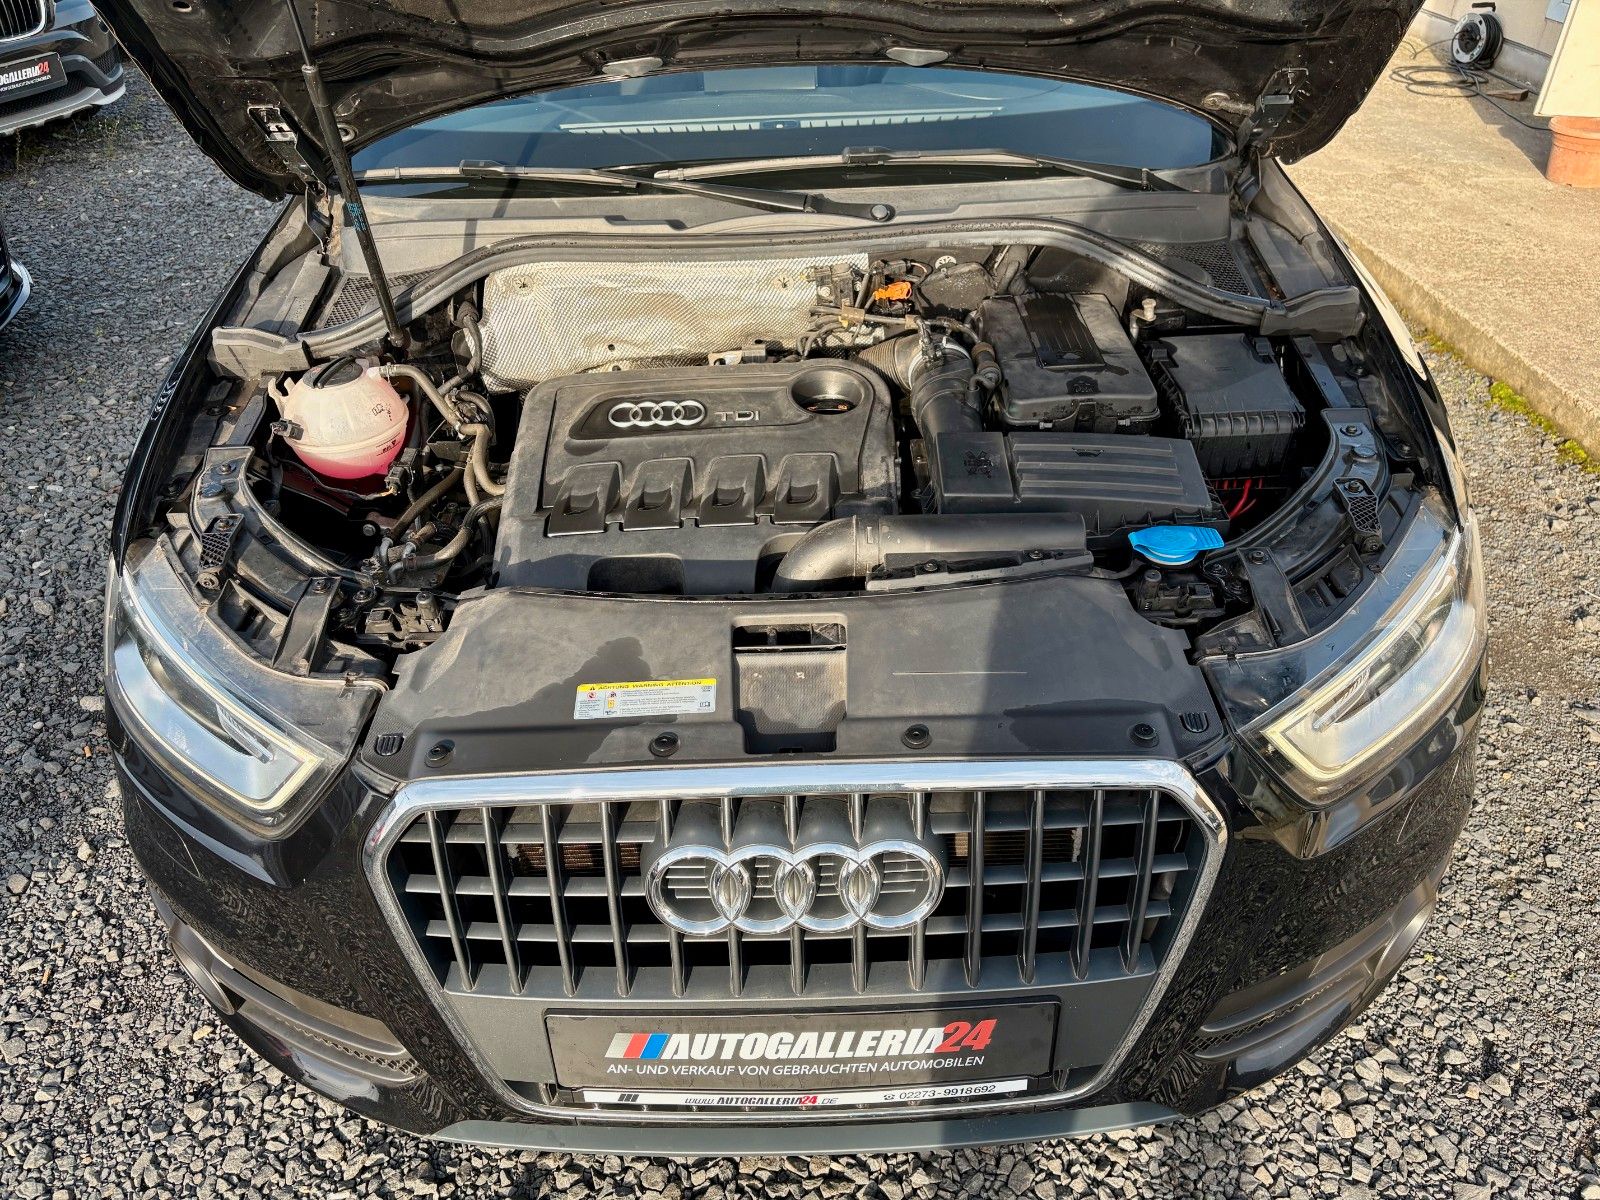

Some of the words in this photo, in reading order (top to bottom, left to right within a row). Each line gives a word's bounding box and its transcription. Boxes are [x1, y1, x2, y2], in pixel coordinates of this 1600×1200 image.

[714, 410, 760, 421] TDI
[659, 1018, 998, 1060] AUTOGALLERIA24
[606, 1064, 633, 1074] AN-
[636, 1065, 669, 1075] UND
[671, 1065, 736, 1076] VERKAUF
[738, 1065, 770, 1076] VON
[772, 1062, 878, 1076] GEBRAUCHTEN
[879, 1056, 985, 1072] AUTOMOBILEN
